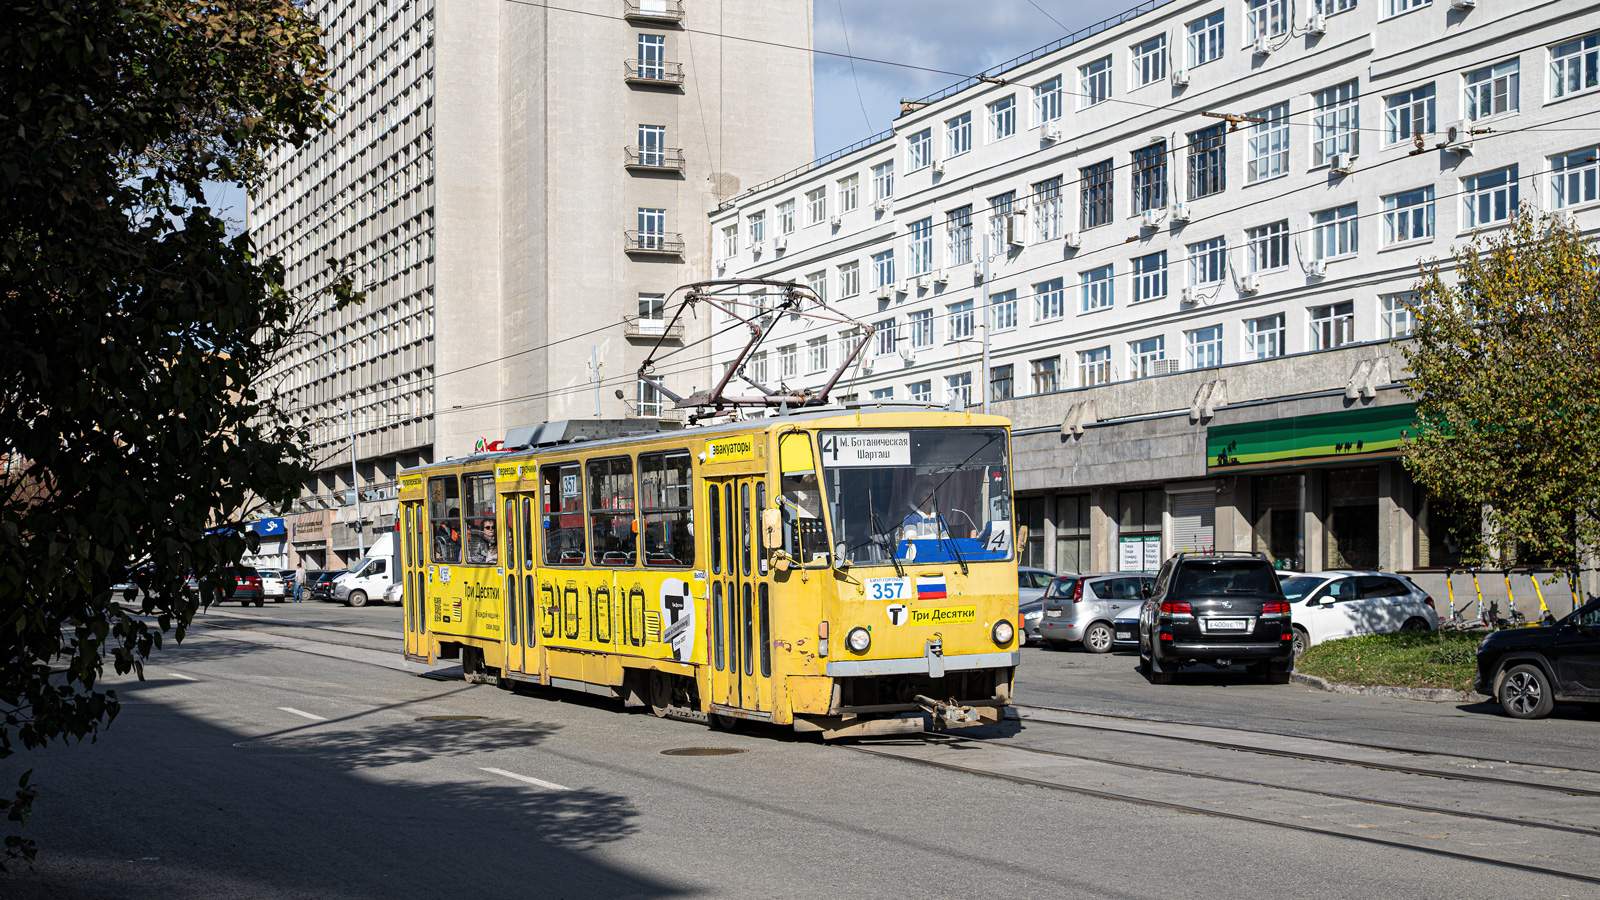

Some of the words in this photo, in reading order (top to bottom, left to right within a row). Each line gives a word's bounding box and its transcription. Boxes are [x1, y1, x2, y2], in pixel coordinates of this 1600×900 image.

[822, 435, 838, 461] 4
[851, 436, 908, 447] Ботаническая
[712, 442, 751, 457] эвакуаторы
[857, 449, 890, 461] Шарташ
[498, 467, 516, 478] переезды
[564, 477, 575, 493] 357
[991, 529, 1005, 548] 4
[464, 581, 475, 601] Три
[475, 582, 500, 602] Десятки
[872, 582, 904, 599] 357
[911, 610, 929, 622] Три
[931, 609, 975, 621] Десятки
